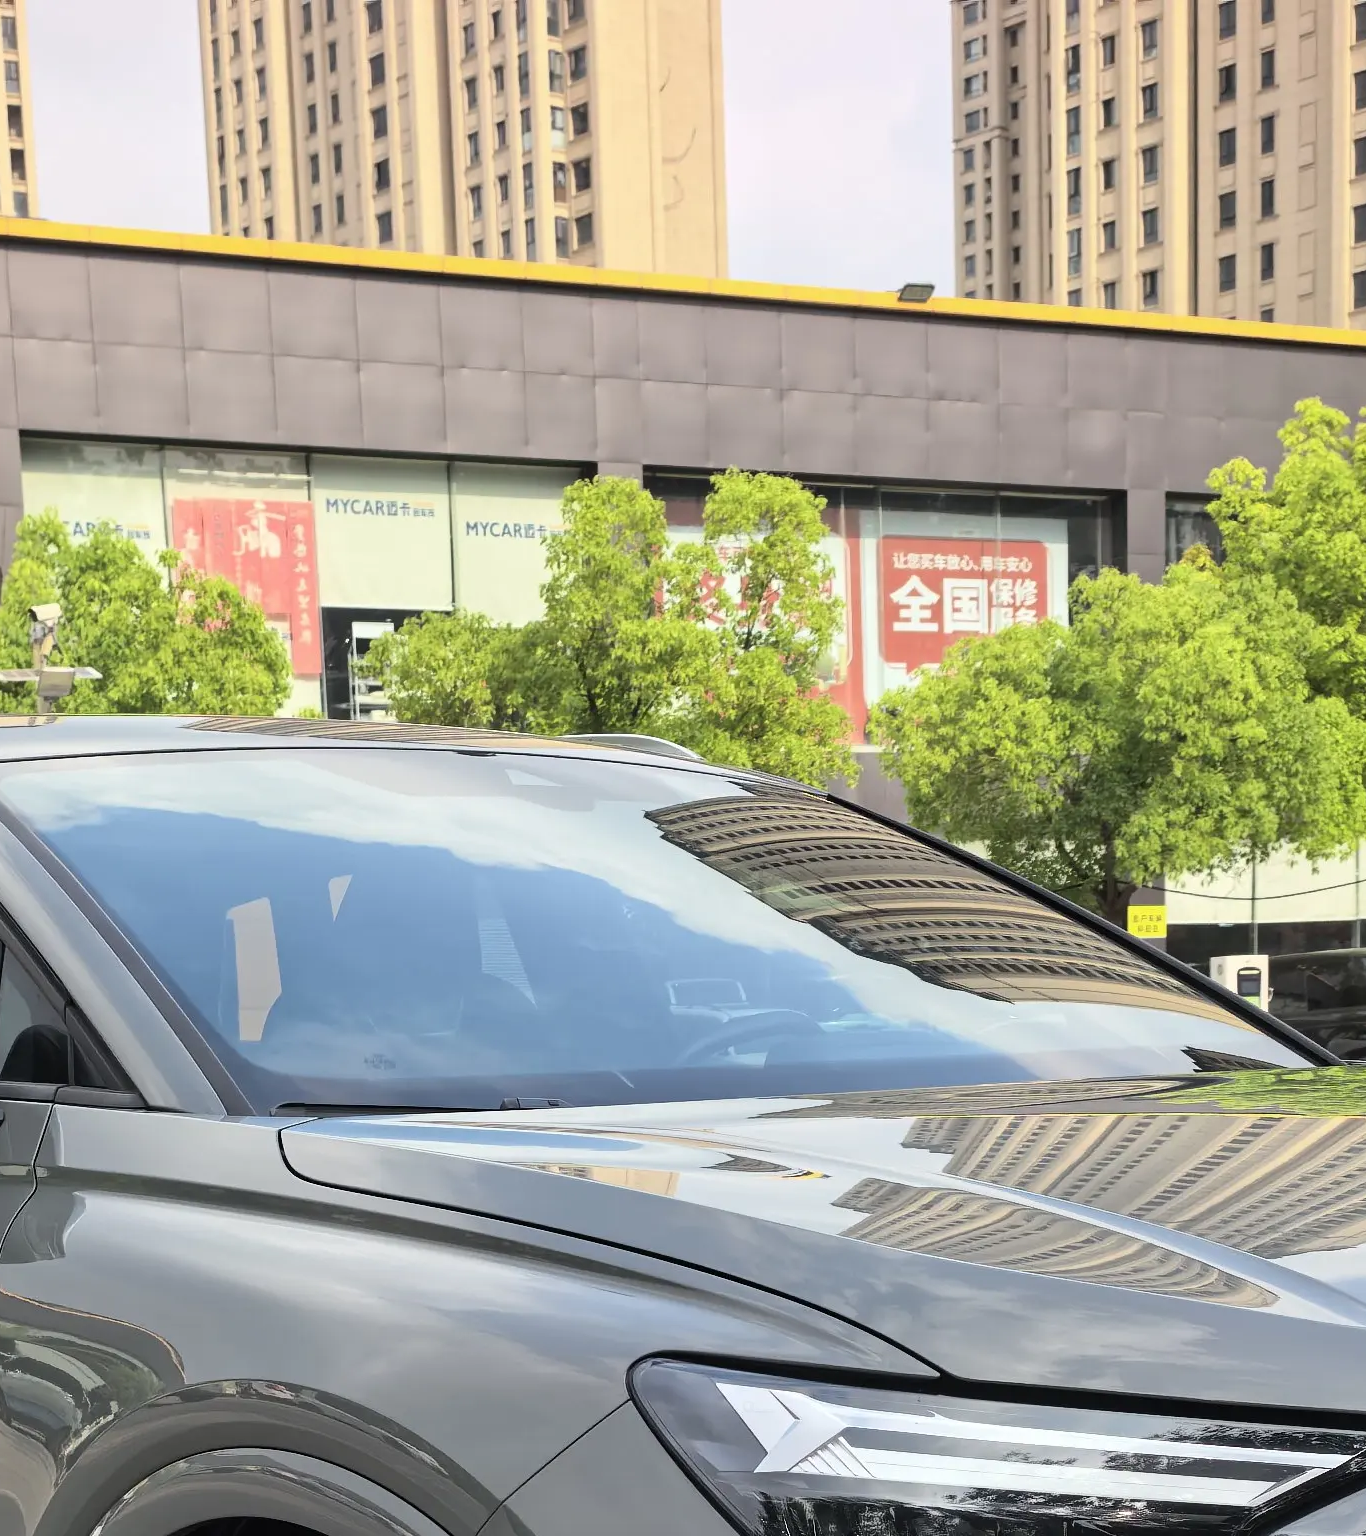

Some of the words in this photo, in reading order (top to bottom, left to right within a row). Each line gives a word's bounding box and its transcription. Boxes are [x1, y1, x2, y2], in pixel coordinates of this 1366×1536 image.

[892, 552, 1032, 572] 让您买车放心、用车安心
[889, 574, 989, 634] 全国
[990, 577, 1038, 606] 保修
